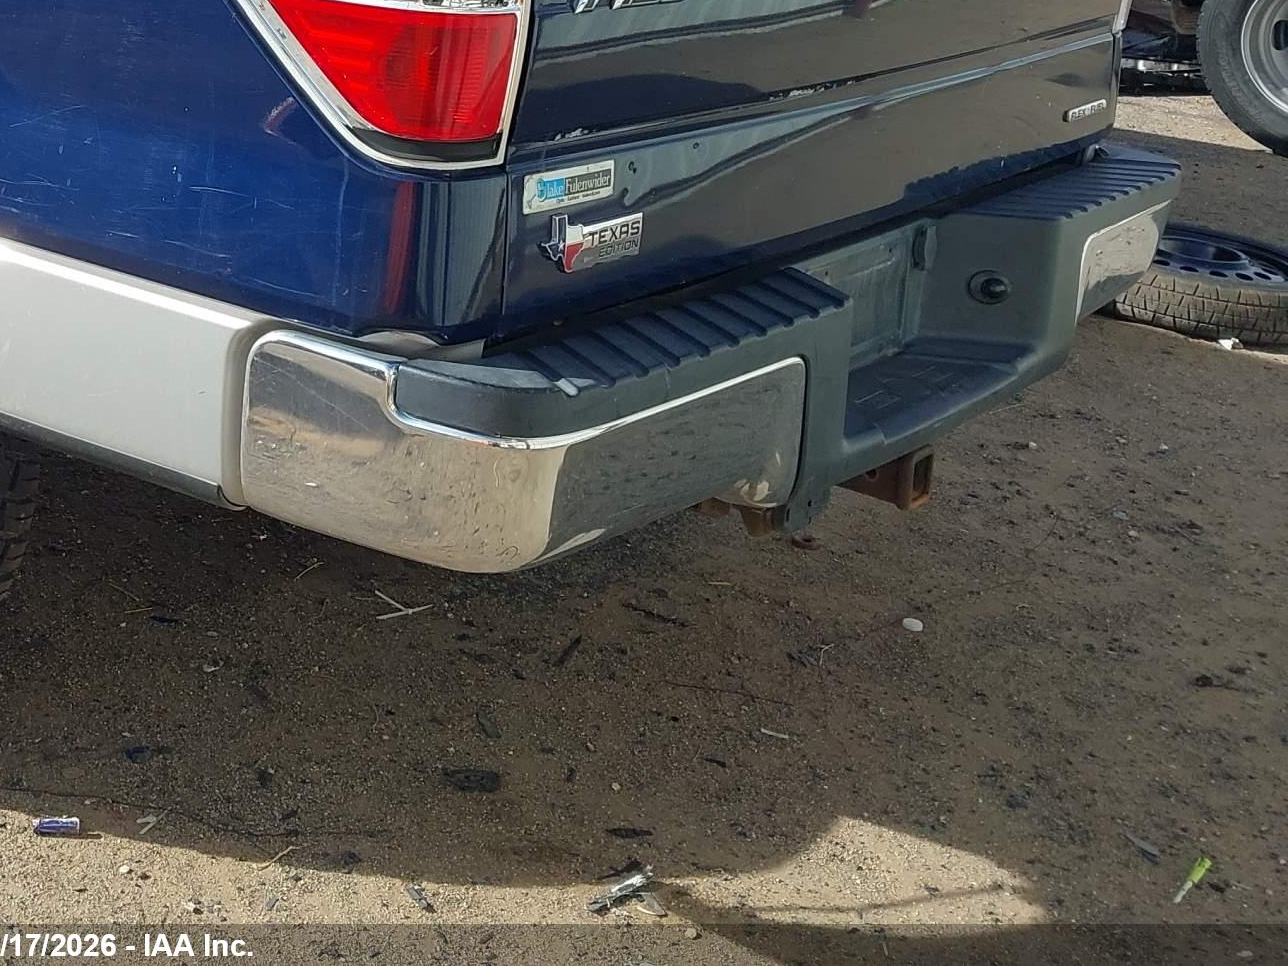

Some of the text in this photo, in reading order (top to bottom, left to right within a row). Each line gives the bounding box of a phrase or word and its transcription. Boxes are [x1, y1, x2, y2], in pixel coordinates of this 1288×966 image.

[565, 174, 610, 194] Fulenwider
[589, 221, 640, 245] TEXAS
[599, 238, 640, 257] EDITION
